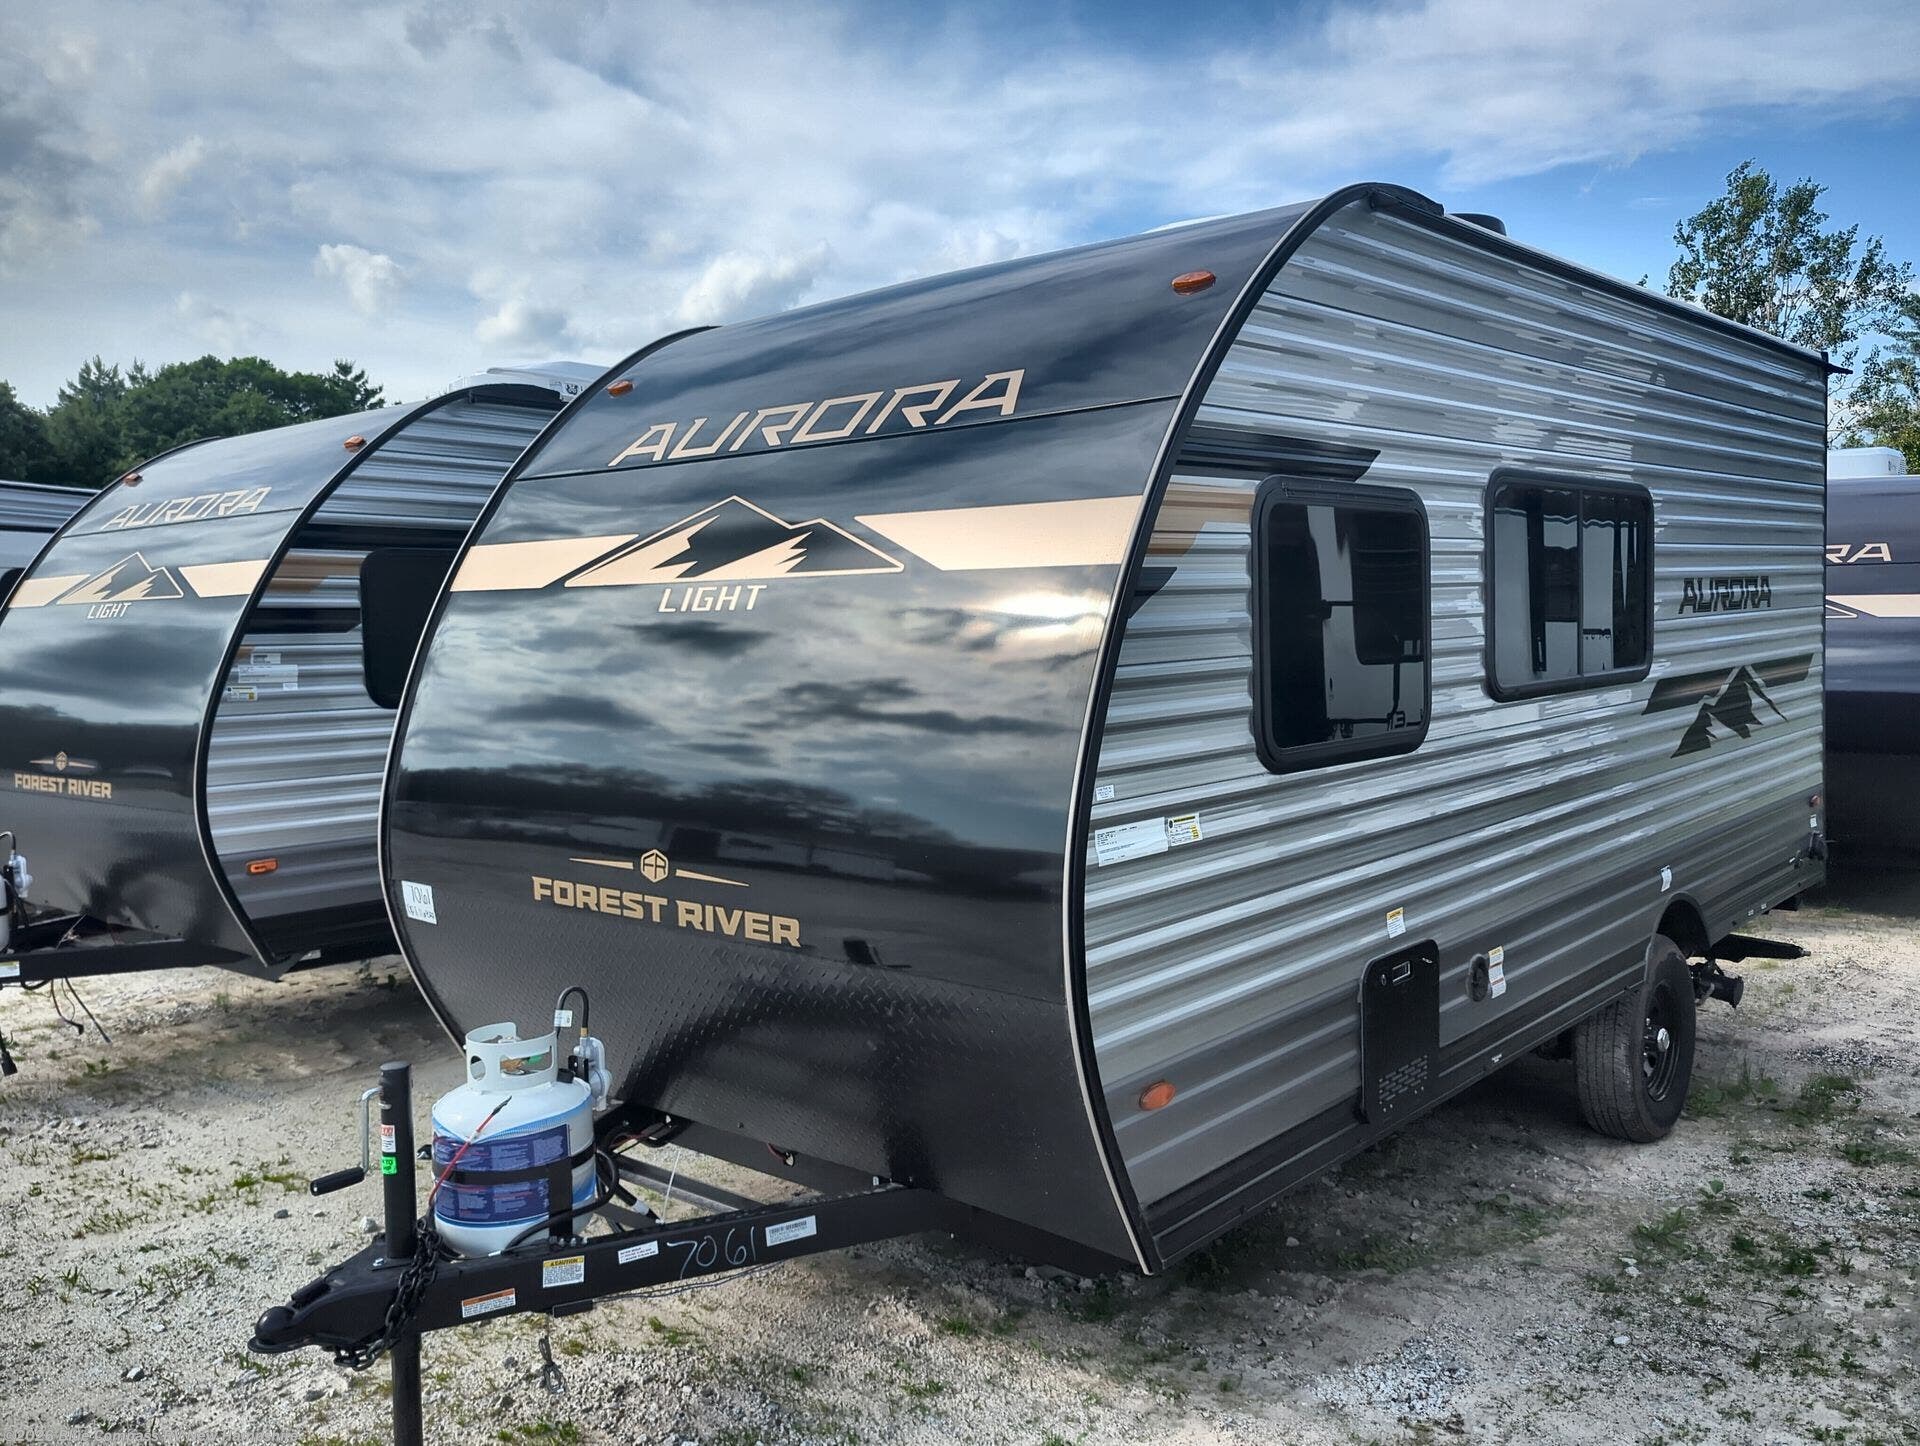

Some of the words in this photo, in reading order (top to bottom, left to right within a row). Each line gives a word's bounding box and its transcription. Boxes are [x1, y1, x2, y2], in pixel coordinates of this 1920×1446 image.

[608, 369, 1025, 467] AURORA
[102, 487, 272, 531] AURORA
[87, 602, 132, 620] LIGHT
[657, 585, 767, 613] LIGHT
[1678, 576, 1772, 615] AURORA
[14, 773, 65, 793] FOREST
[68, 778, 112, 799] RIVER
[531, 876, 668, 922] FOREST
[676, 899, 801, 947] RIVER
[667, 1226, 757, 1280] 7061
